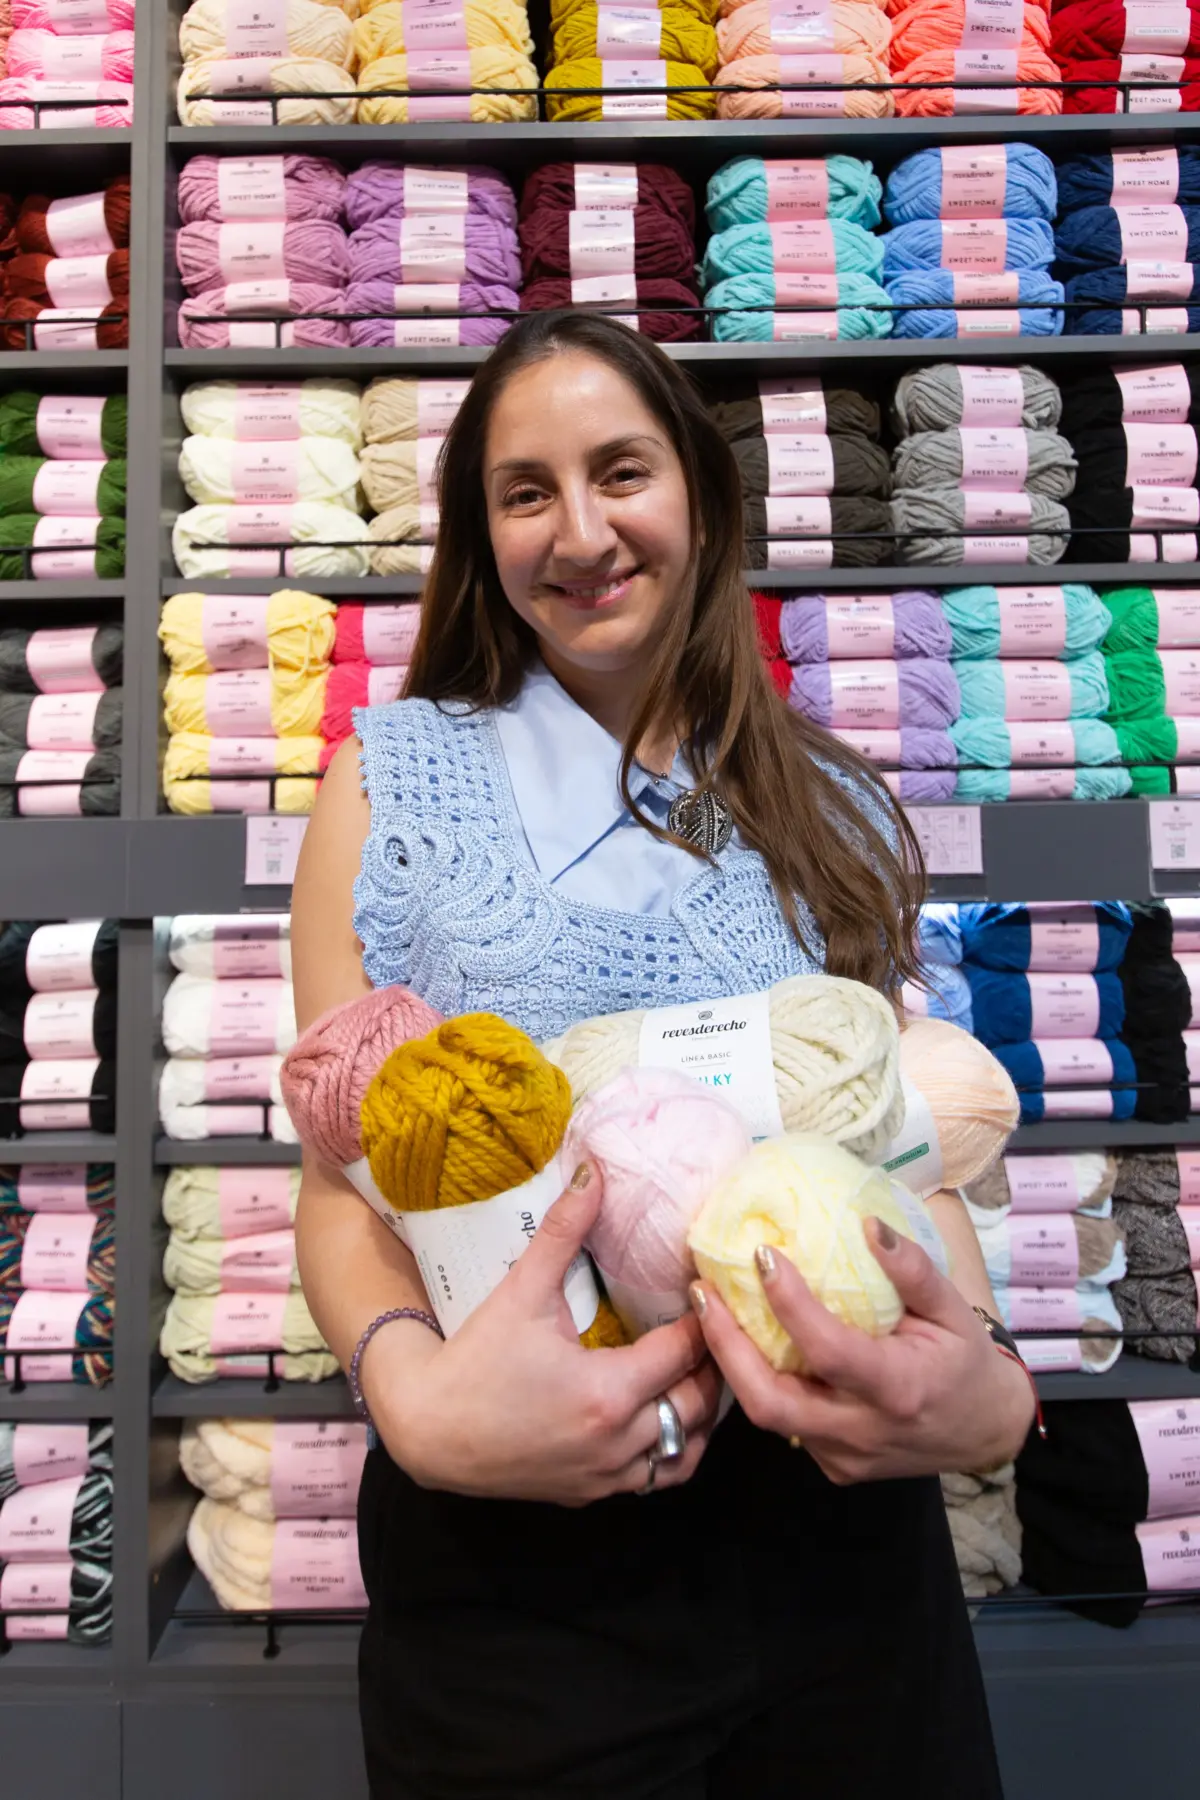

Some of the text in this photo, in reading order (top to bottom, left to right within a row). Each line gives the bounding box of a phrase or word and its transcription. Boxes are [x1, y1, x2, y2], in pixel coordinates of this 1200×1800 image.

[970, 24, 1016, 34] SWEET HOME
[662, 1020, 747, 1039] revesderecho
[707, 1051, 732, 1060] BASIC
[1168, 1470, 1196, 1481] SWEET
